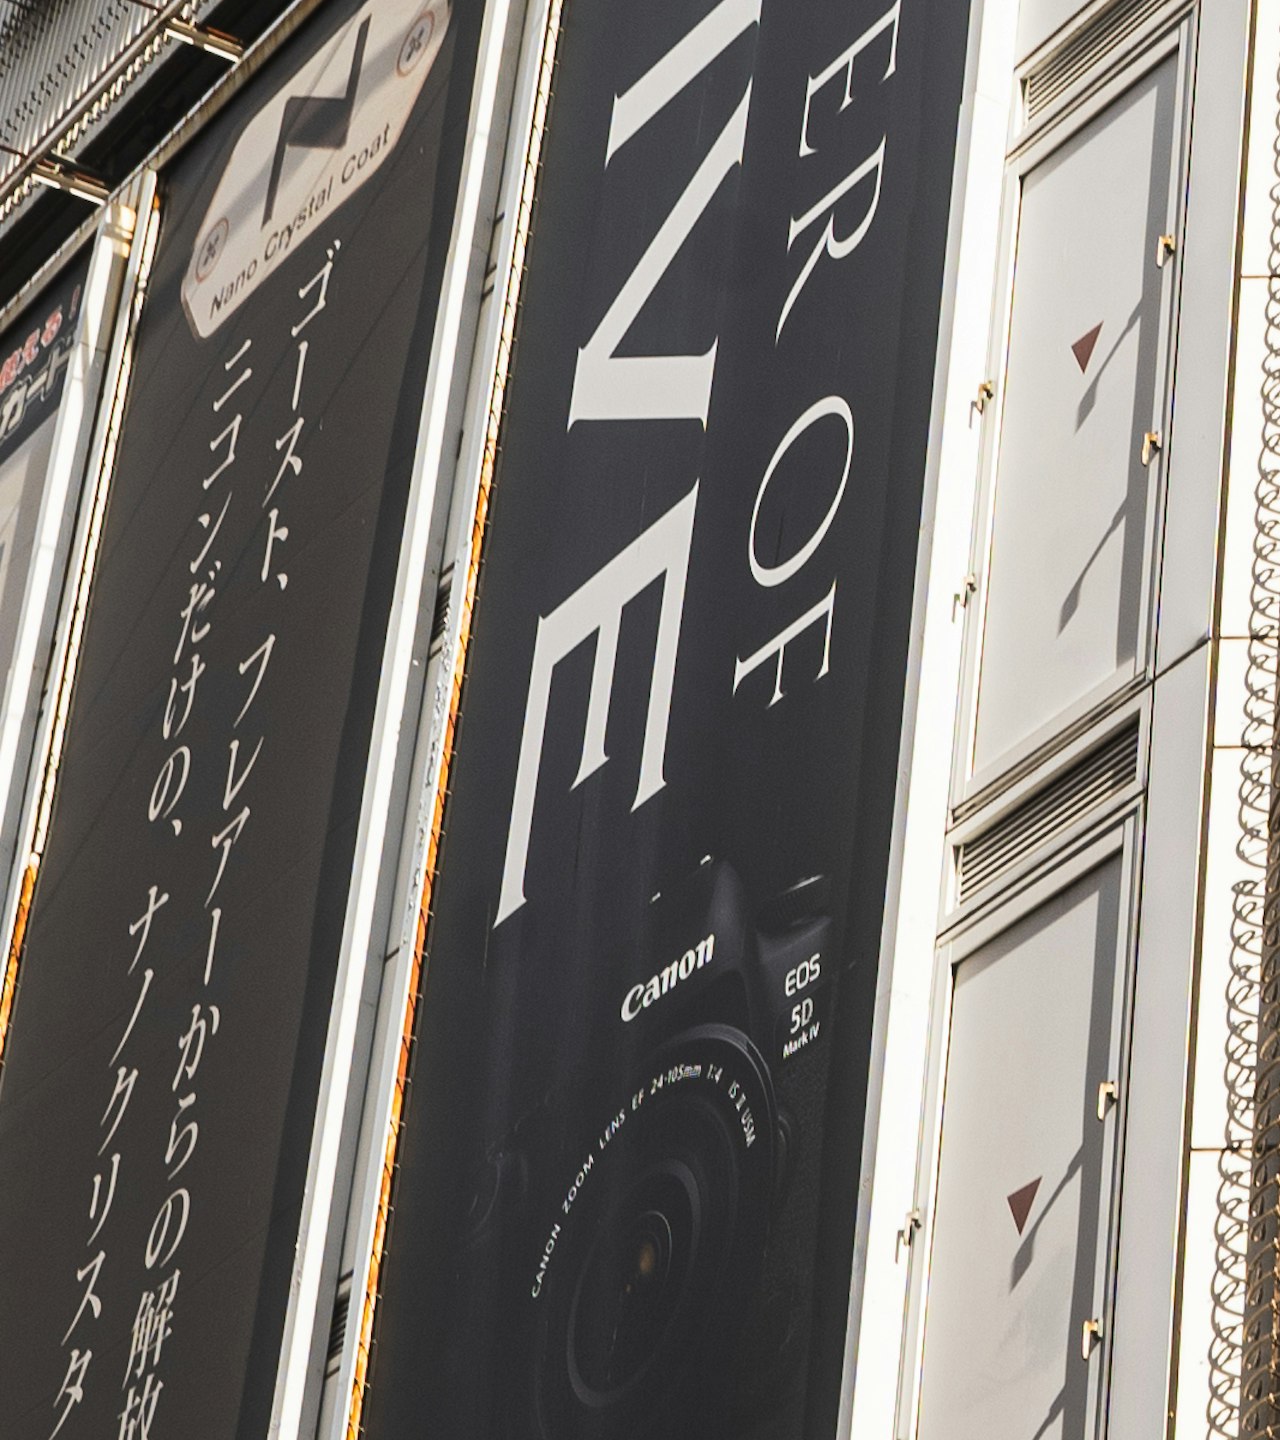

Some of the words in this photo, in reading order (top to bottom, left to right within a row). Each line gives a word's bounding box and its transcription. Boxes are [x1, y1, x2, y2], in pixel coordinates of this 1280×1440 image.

[207, 261, 258, 320] Nano
[263, 178, 335, 264] Crystal
[339, 120, 392, 210] Coat
[732, 395, 855, 710] OF
[620, 933, 716, 1023] Canon
[784, 953, 821, 999] EOS
[789, 997, 815, 1035] 5D
[530, 1223, 564, 1300] CANON
[559, 1154, 595, 1216] ZOOM
